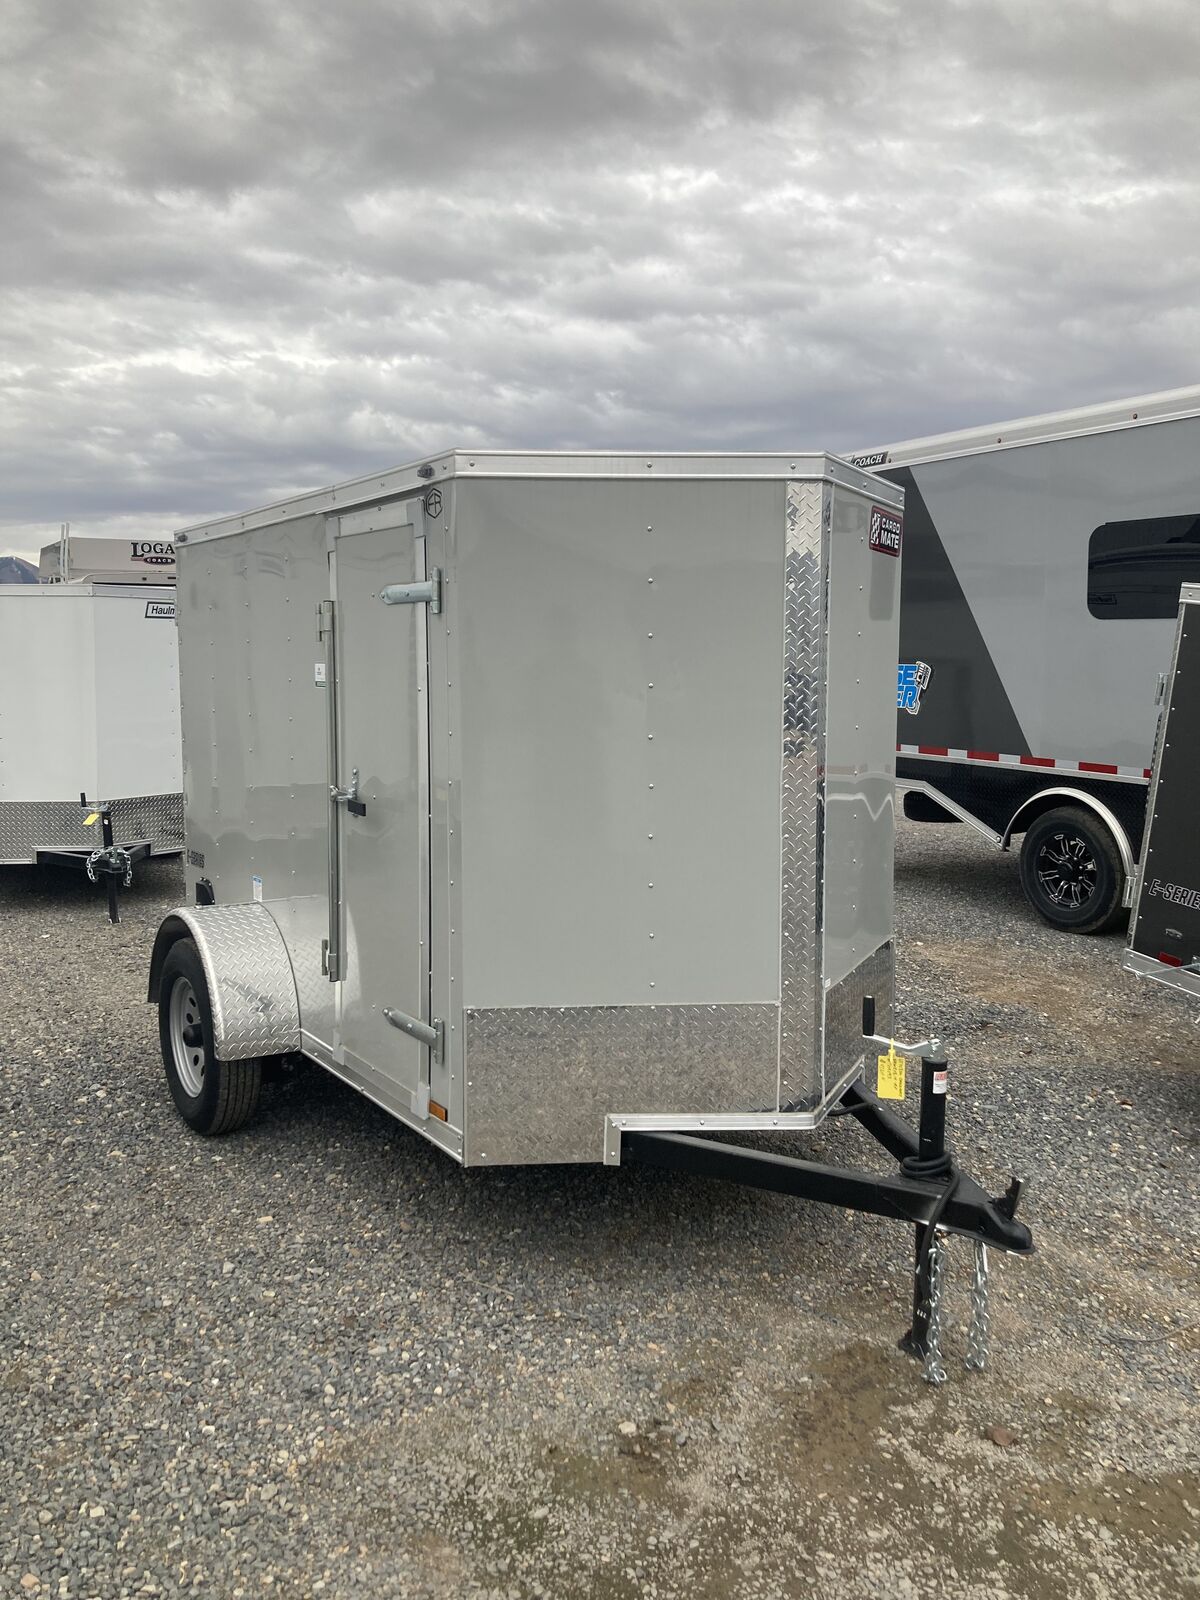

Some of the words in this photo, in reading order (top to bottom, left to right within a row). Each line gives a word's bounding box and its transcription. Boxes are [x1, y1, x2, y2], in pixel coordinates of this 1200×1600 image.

[854, 454, 883, 467] COACH
[882, 518, 900, 534] CARGO
[881, 530, 899, 549] MATE
[131, 542, 175, 558] LOGA
